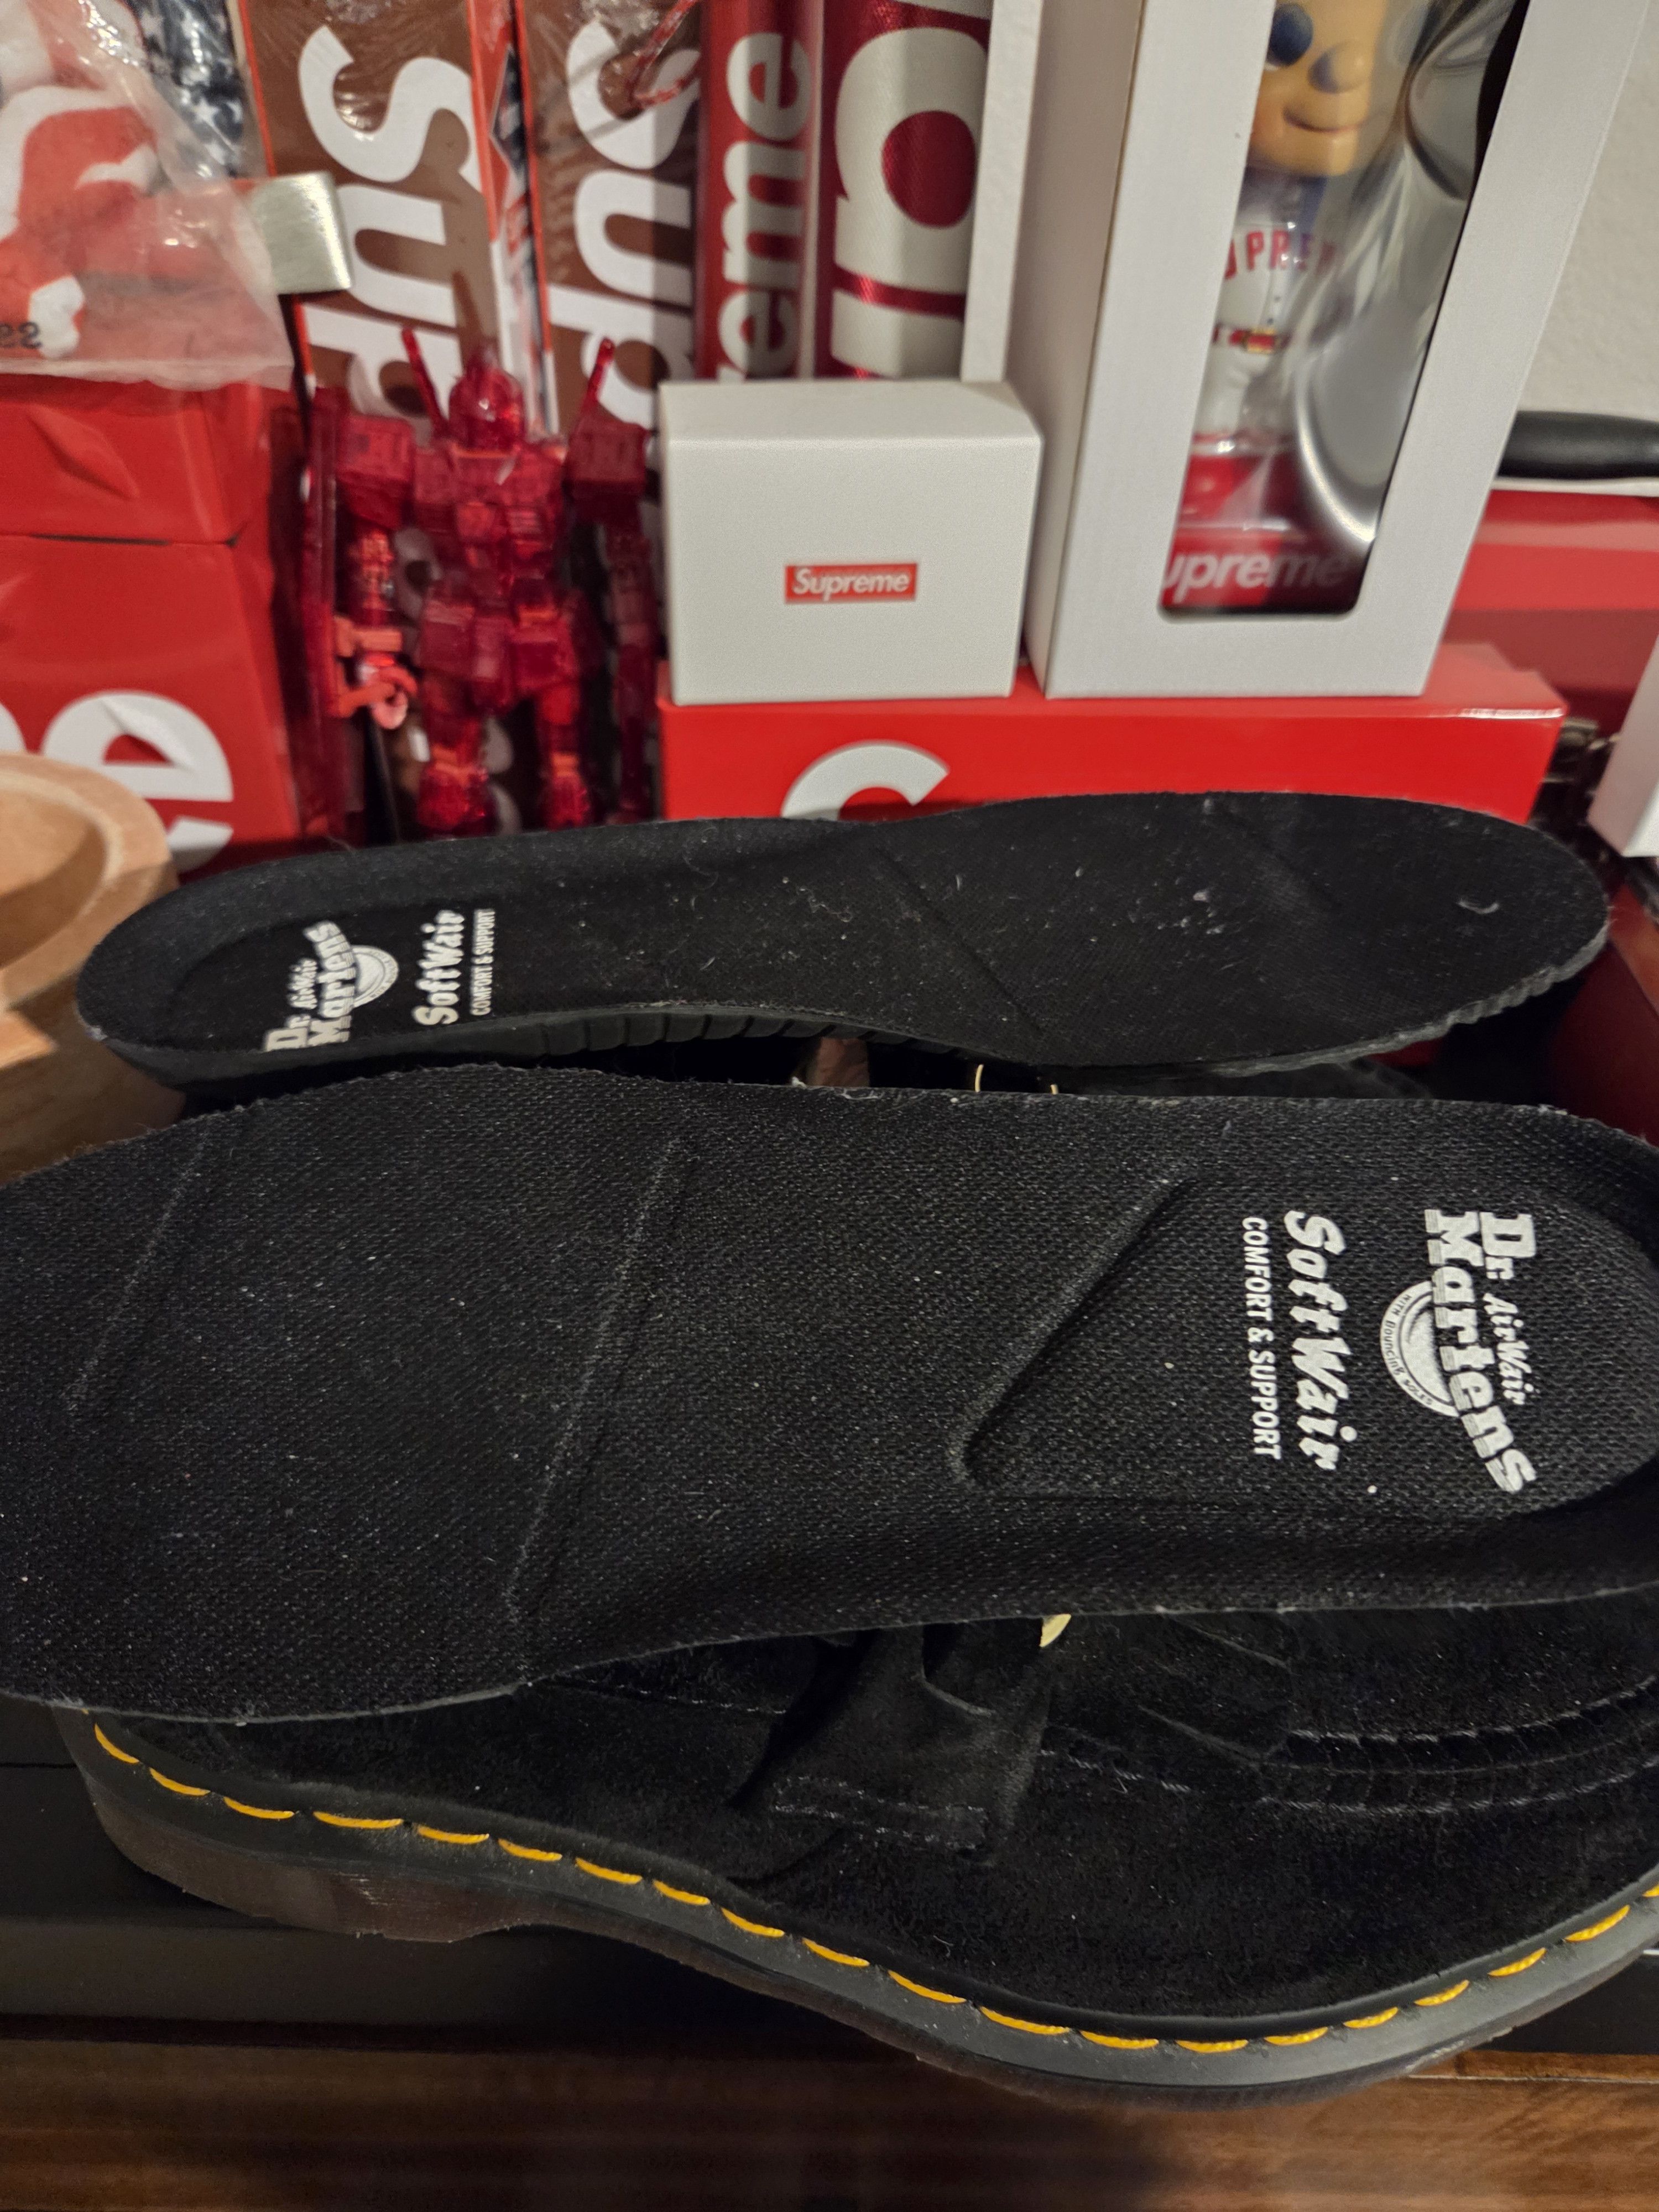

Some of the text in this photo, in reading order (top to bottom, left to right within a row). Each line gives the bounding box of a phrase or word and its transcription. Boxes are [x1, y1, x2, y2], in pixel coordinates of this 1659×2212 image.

[793, 567, 910, 602] Supreme
[304, 920, 356, 1046] Martens
[412, 910, 465, 1026] SoftWair
[471, 909, 495, 1016] COMFORT & SUPPORT
[1242, 1217, 1282, 1460] COMFORT & SUPPORT
[1284, 1210, 1357, 1470] SoftWair
[1390, 1293, 1412, 1316] WITH
[1425, 1209, 1537, 1493] Martens
[1483, 1293, 1535, 1405] AirWair
